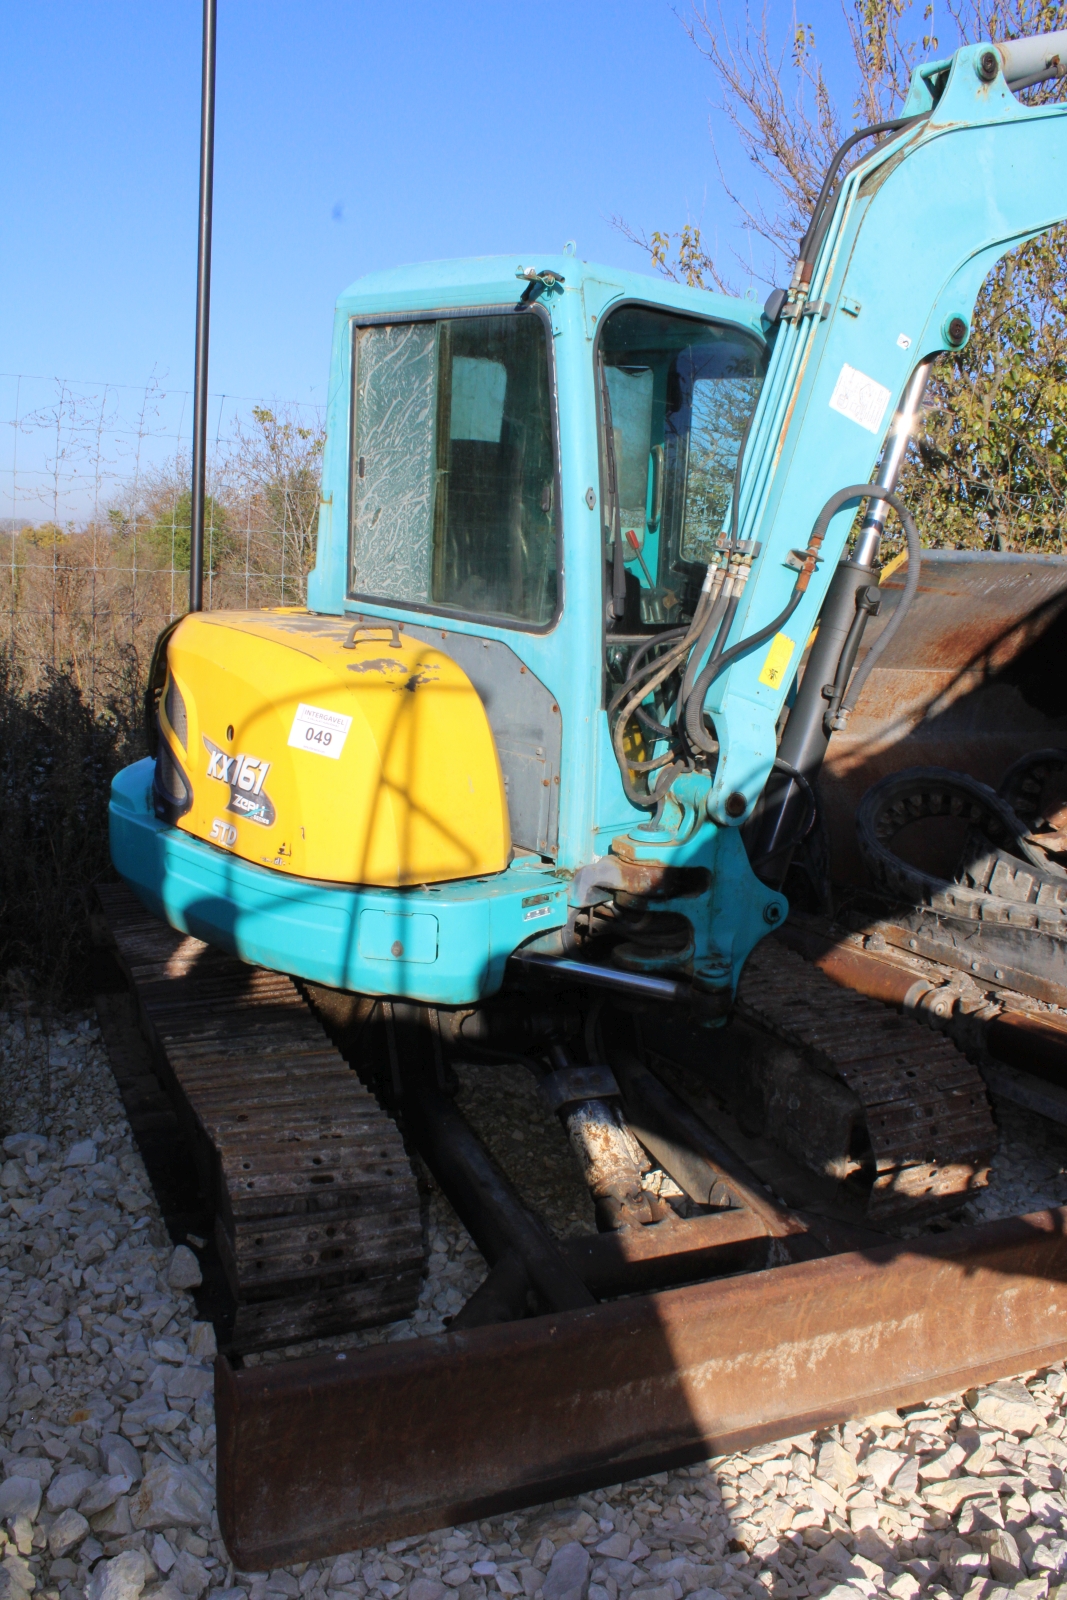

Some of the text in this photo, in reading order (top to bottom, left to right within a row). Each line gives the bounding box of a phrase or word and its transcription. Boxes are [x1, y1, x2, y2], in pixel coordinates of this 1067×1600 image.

[304, 709, 345, 726] INTERGAVEL
[305, 727, 333, 746] 049
[207, 750, 271, 795] KX161
[209, 819, 238, 846] STD
